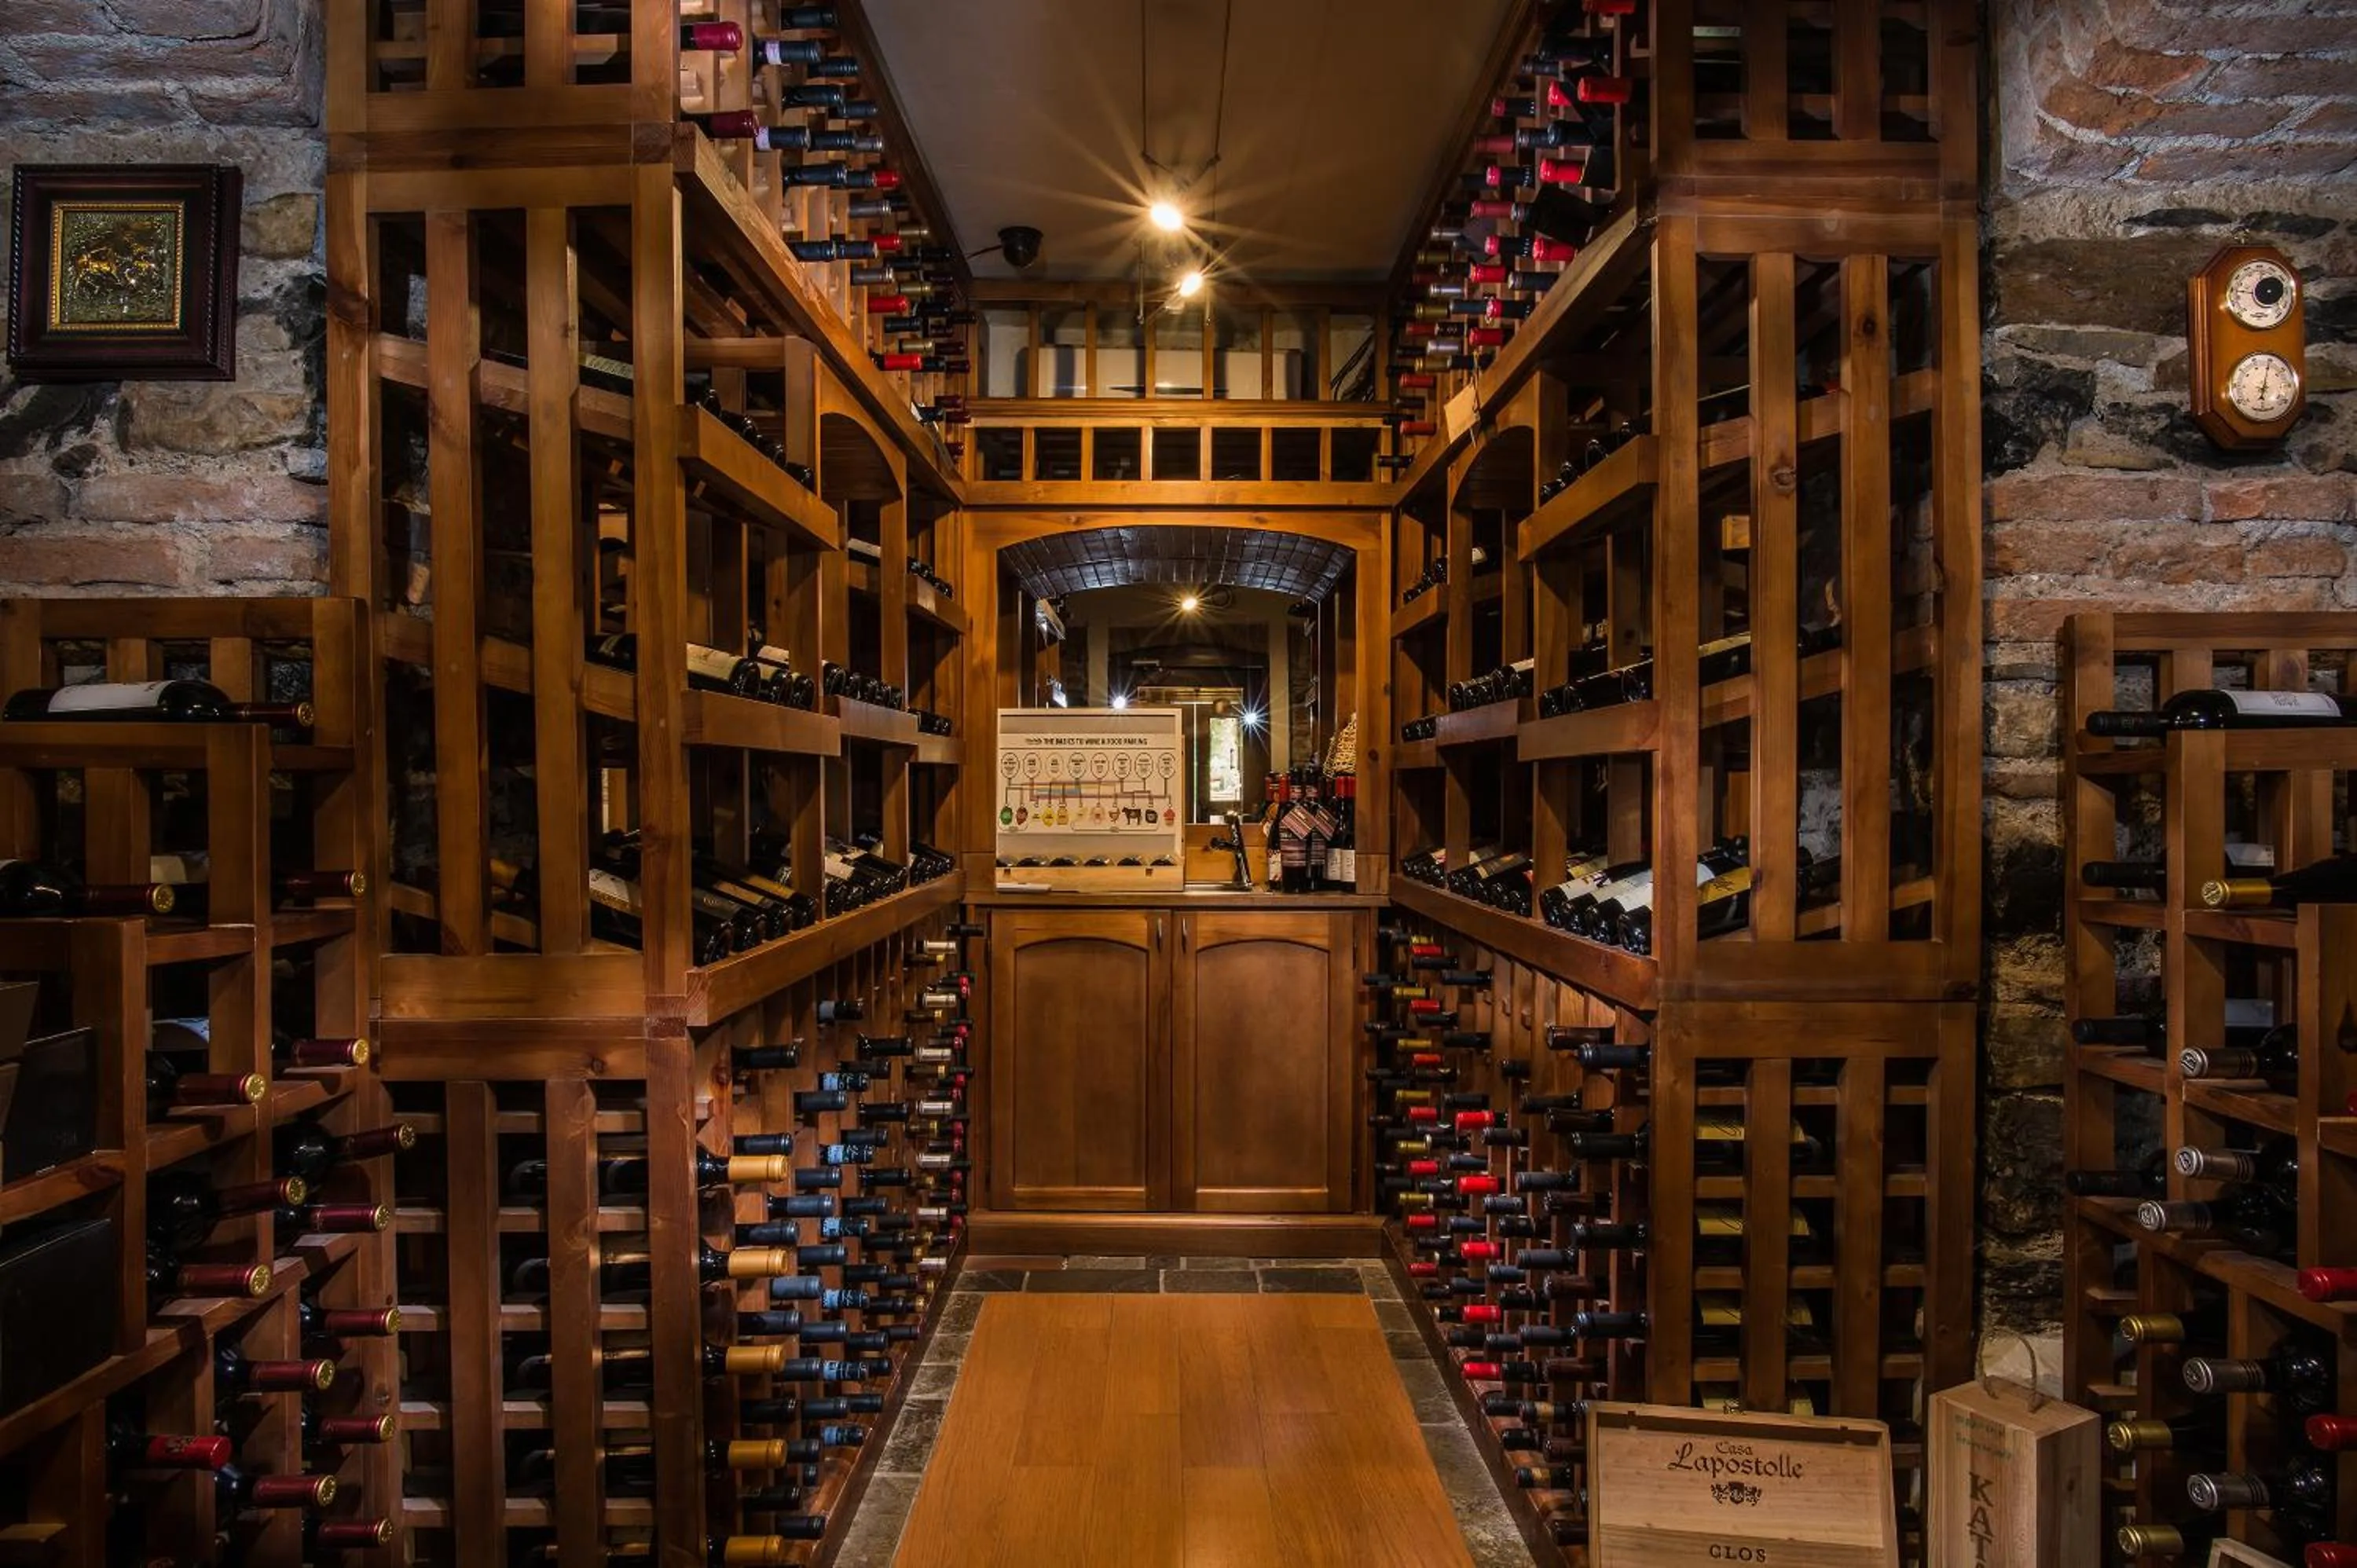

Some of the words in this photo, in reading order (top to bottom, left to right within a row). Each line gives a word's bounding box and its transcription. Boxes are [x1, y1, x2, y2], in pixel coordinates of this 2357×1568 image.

[1667, 1441, 1804, 1478] Lapostolle
[1715, 1441, 1754, 1456] Casa
[1967, 1471, 1994, 1568] KAT
